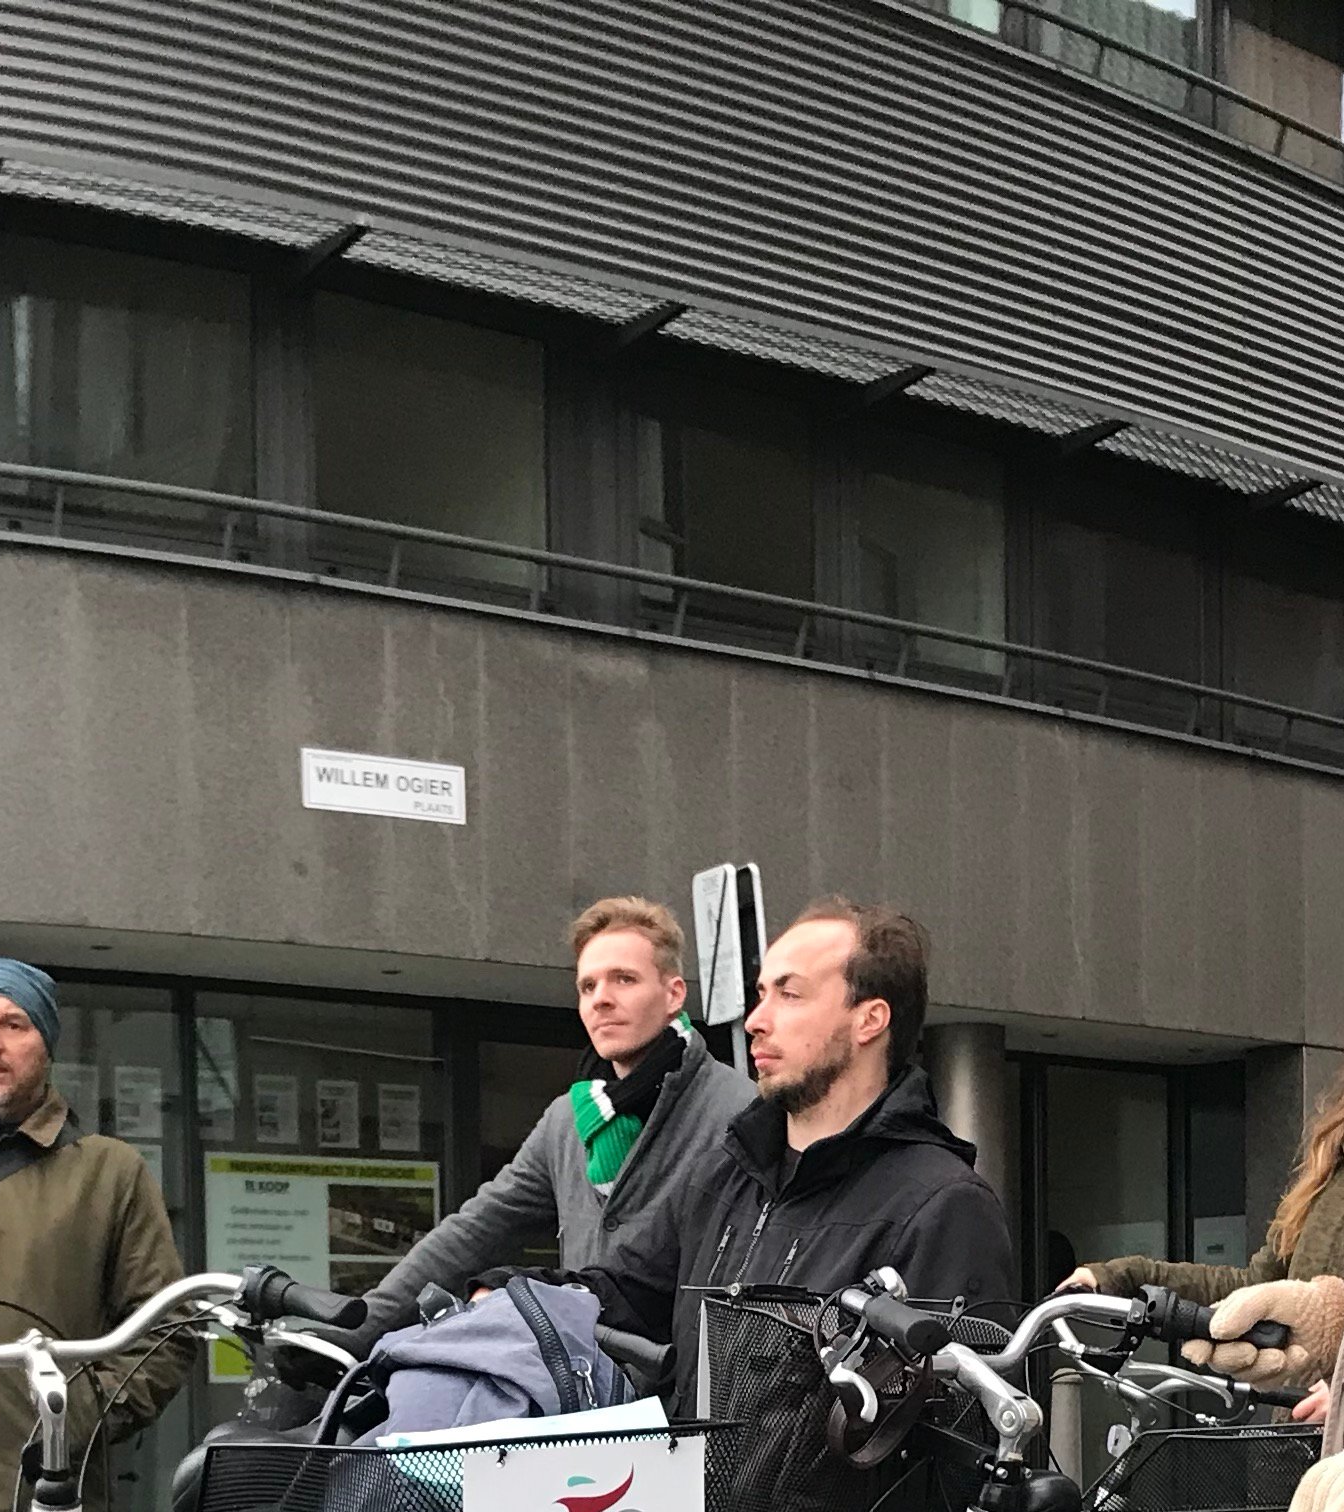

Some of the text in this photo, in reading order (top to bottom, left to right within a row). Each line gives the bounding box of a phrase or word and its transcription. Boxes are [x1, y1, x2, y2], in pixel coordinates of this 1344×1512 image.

[315, 766, 454, 797] WILLEM OGIER
[413, 801, 454, 815] PLAATS
